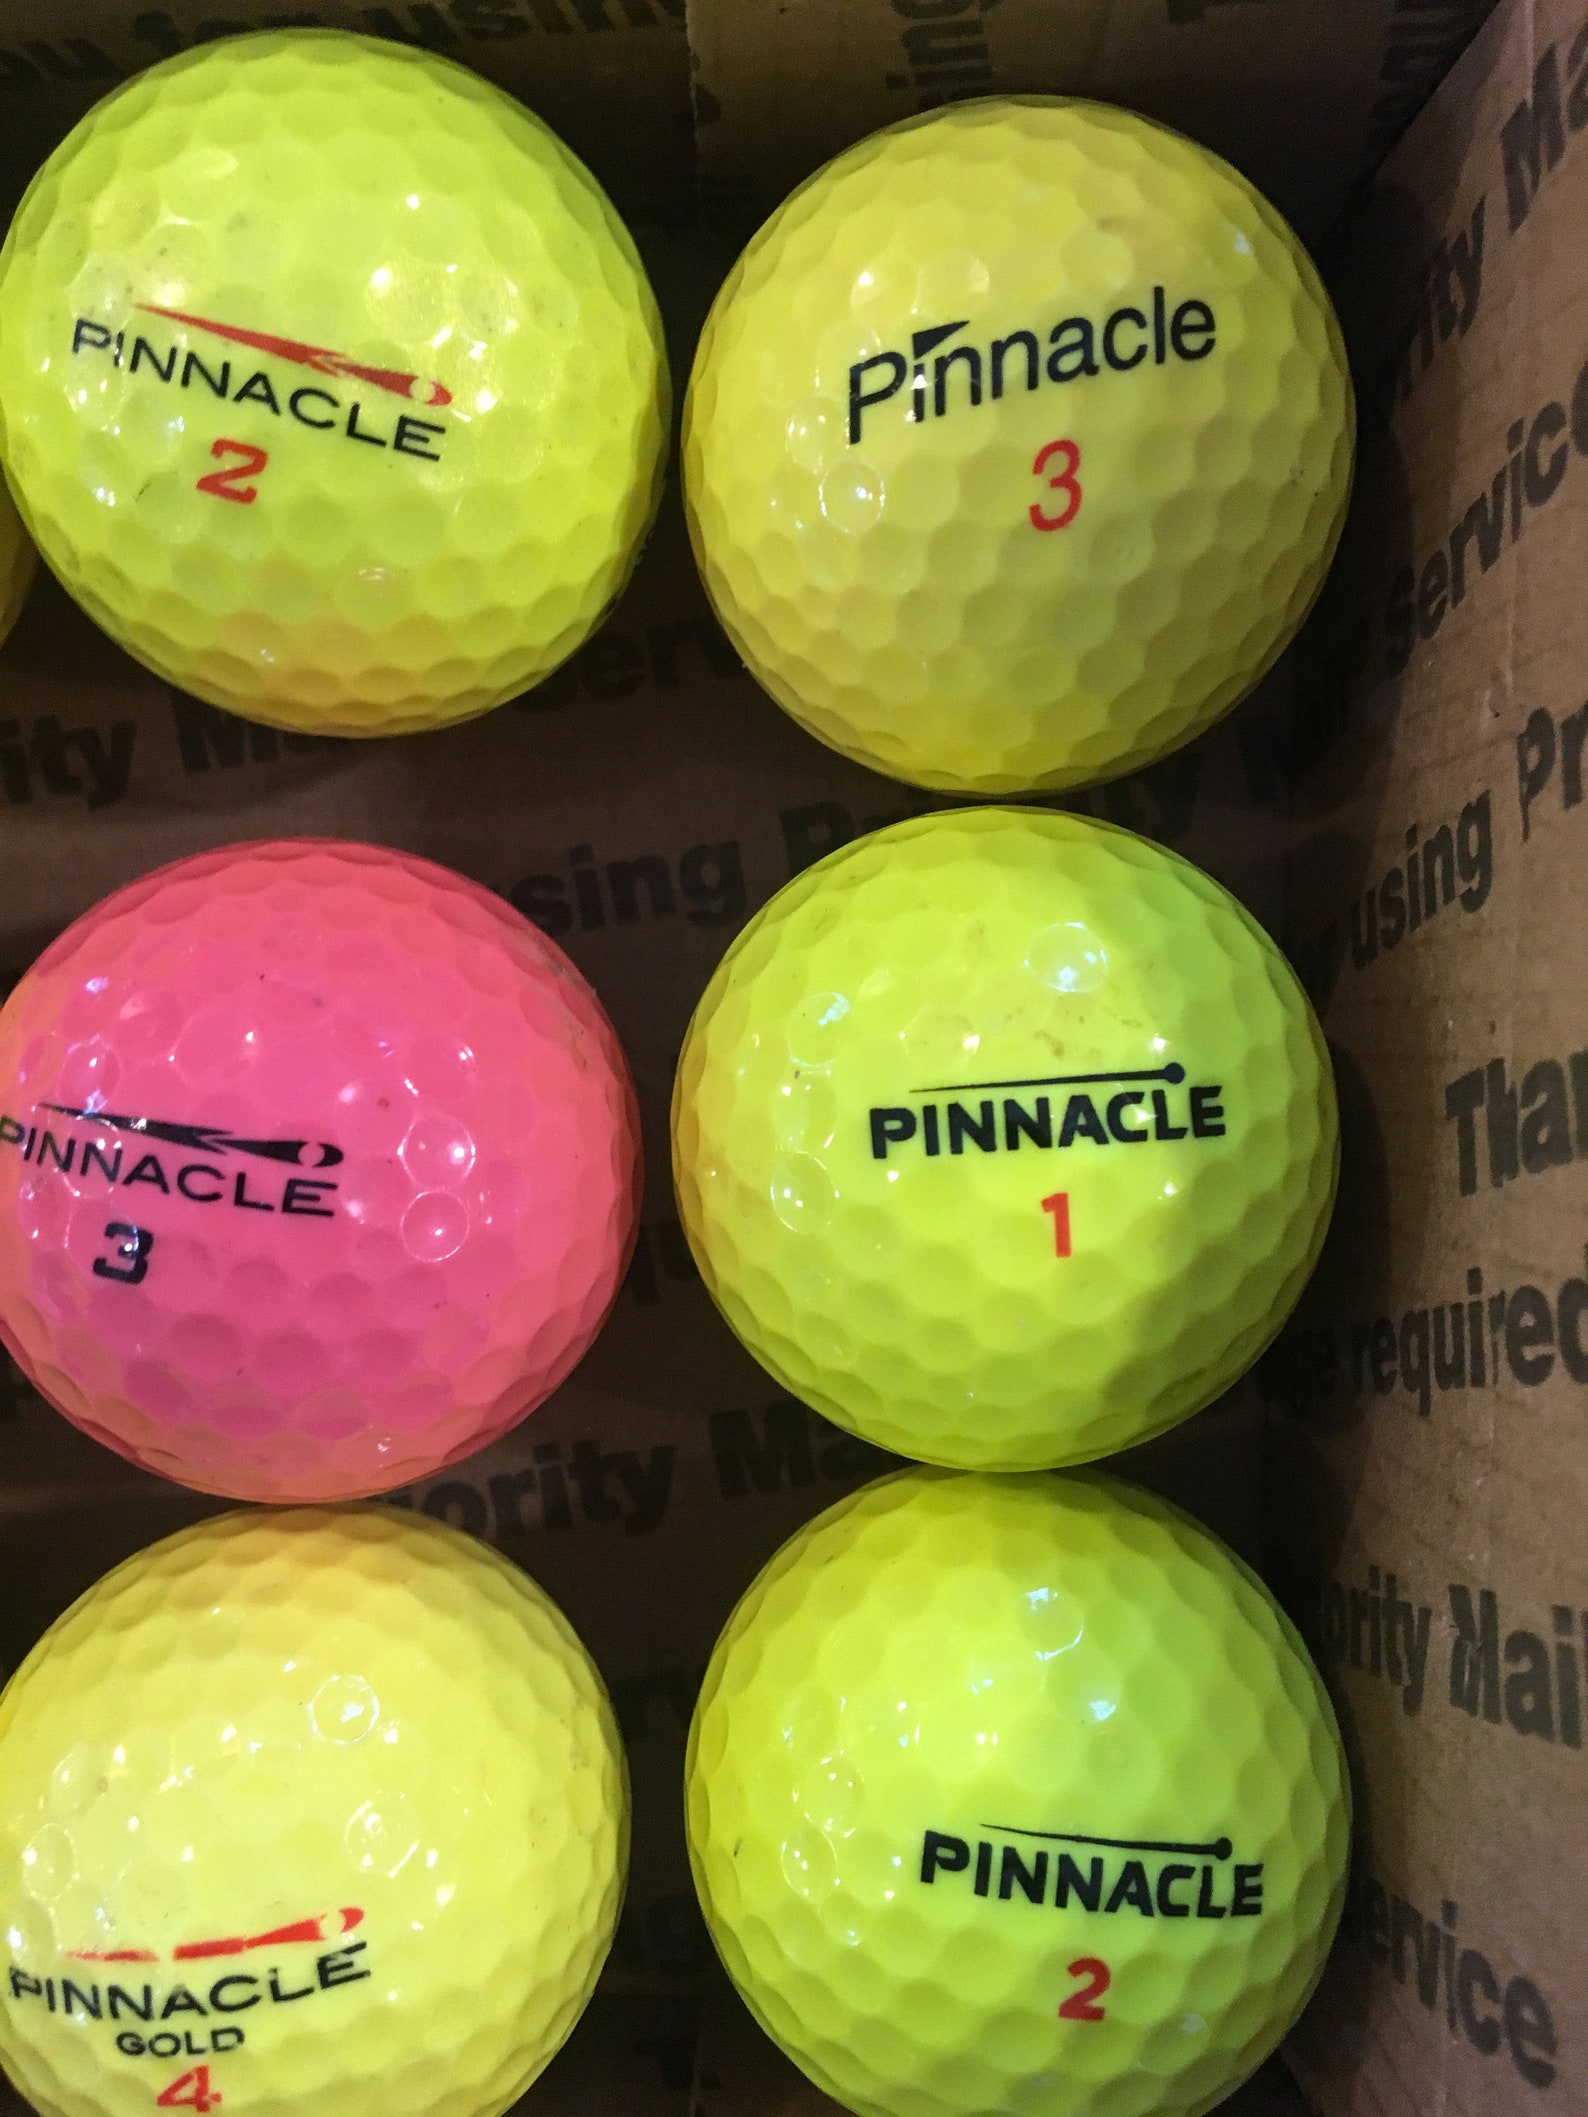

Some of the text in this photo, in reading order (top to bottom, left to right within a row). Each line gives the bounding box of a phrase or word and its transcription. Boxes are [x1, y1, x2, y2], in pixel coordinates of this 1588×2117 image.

[72, 317, 447, 462] PINNACLE
[848, 286, 1217, 444] Pinnacle
[196, 438, 269, 504] 2
[1028, 439, 1083, 532] 3
[492, 841, 748, 938] sing
[1351, 789, 1493, 972] using
[870, 1085, 1226, 1160] PINNACLE
[0, 1113, 339, 1218] PINNACLE
[92, 1222, 154, 1285] 3
[1041, 1192, 1072, 1258] 1
[920, 1830, 1264, 1918] PINNACLE
[8, 1940, 372, 2022] PINNACLE
[1058, 1957, 1111, 2021] 2
[1361, 1875, 1558, 2090] ervice
[115, 2026, 245, 2058] GOLD
[156, 2065, 223, 2113] 4
